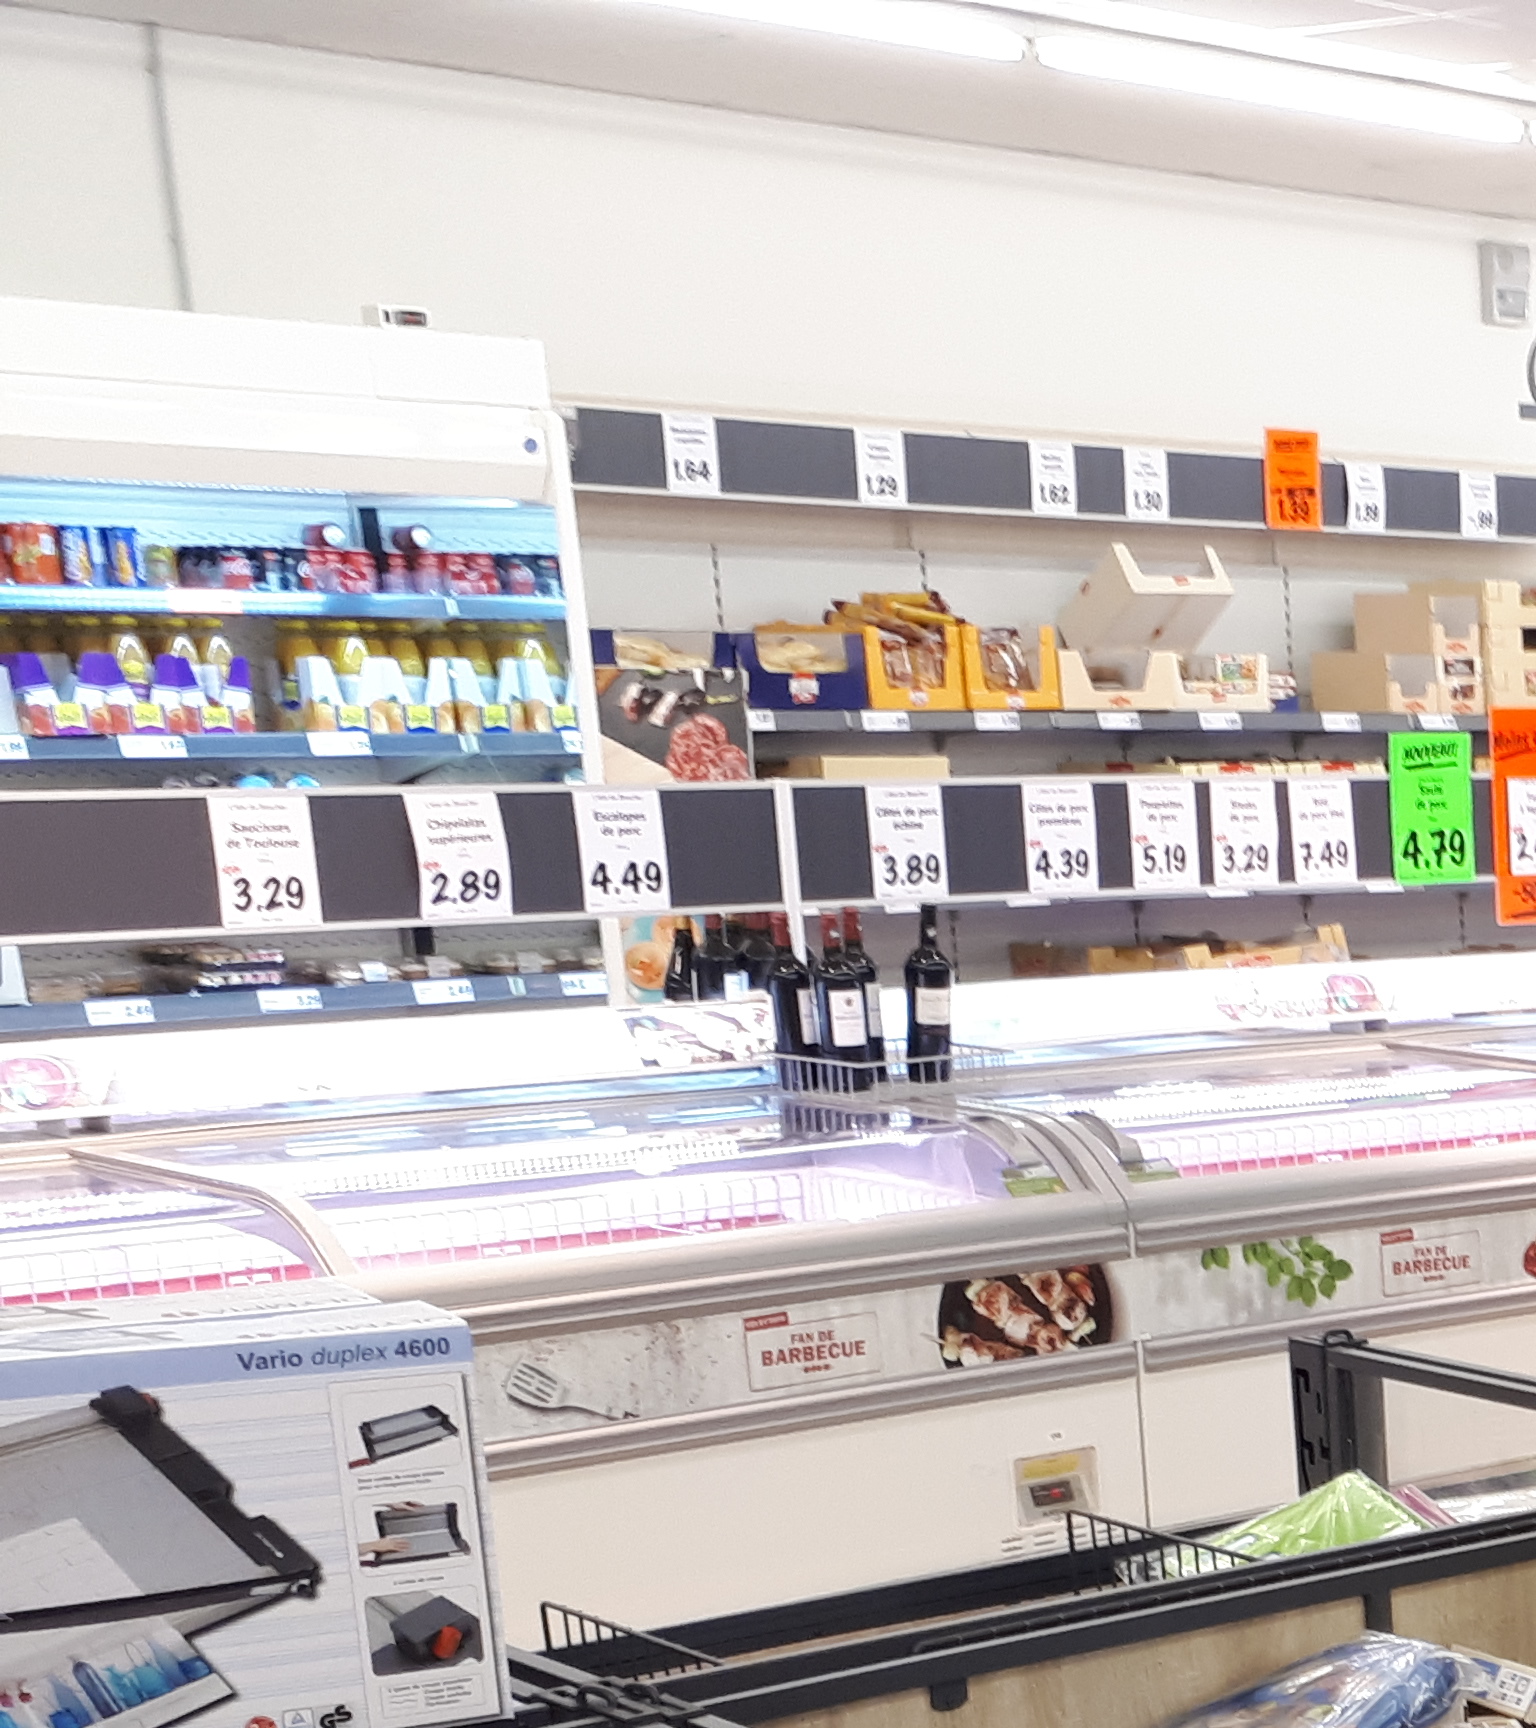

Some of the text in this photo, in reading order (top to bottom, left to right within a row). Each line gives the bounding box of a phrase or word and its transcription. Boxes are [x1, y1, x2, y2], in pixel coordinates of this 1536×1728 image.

[1034, 848, 1090, 881] 4.39
[1142, 844, 1187, 875] 5.19
[1222, 843, 1269, 873] 3.29
[1299, 839, 1350, 871] 7.49
[1402, 829, 1466, 870] 4.79
[590, 860, 664, 895] 4.49
[883, 852, 942, 887] 3.89
[233, 875, 306, 913] 3.29
[431, 868, 501, 906] 2.89
[1393, 1254, 1471, 1276] BARBECUE
[761, 1340, 866, 1367] BARBECUE
[791, 1330, 835, 1344] FAN DE
[236, 1337, 451, 1372] Vario duplex 4600
